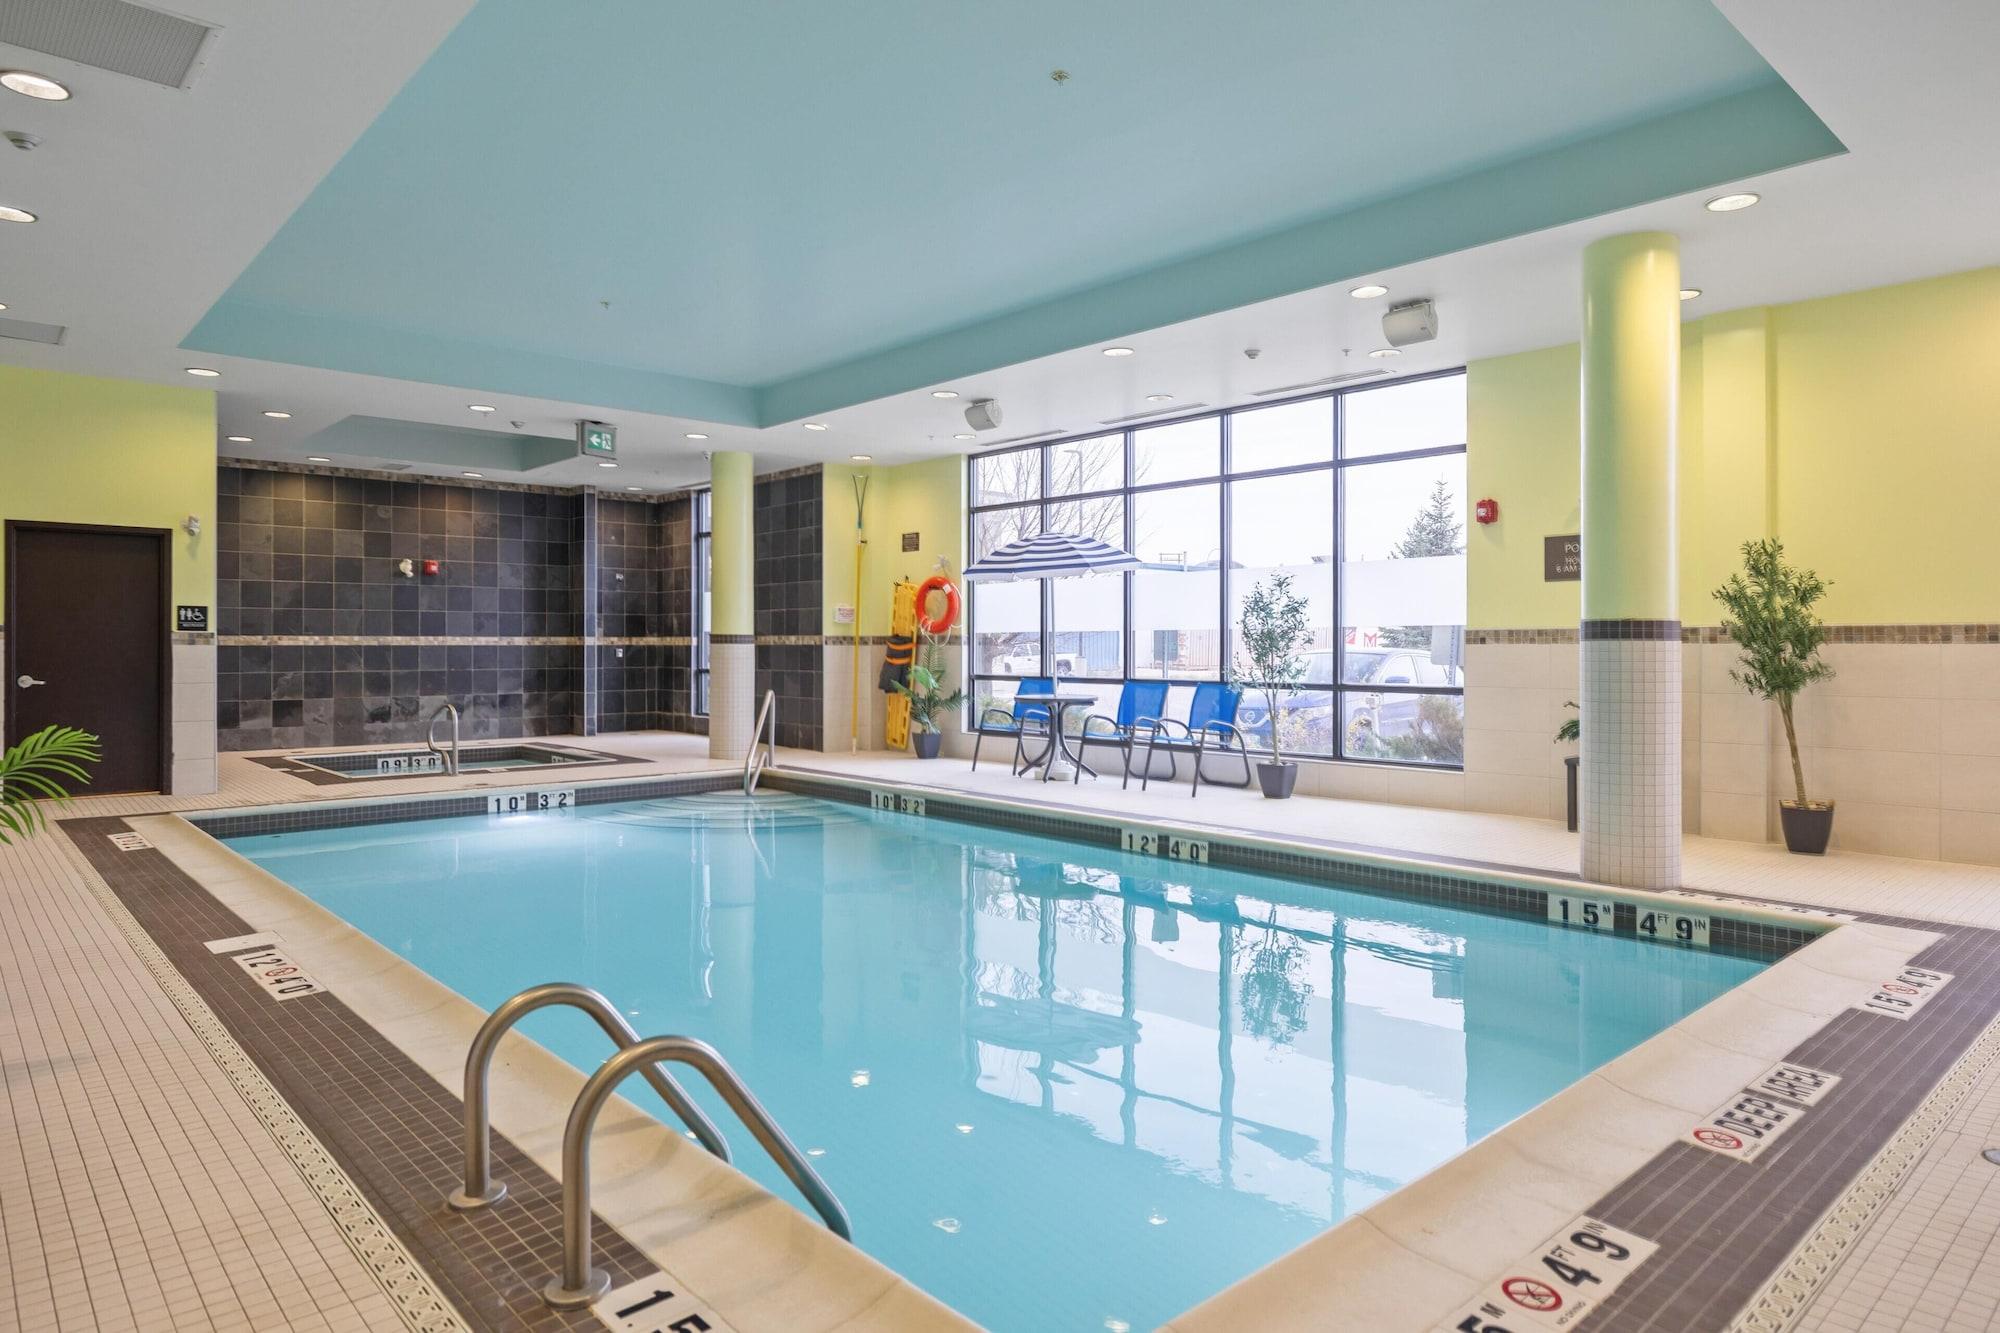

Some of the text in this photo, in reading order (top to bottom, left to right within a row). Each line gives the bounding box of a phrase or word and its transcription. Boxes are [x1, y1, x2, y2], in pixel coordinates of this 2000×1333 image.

[1565, 543, 1580, 554] PO
[1713, 1067, 1831, 1139] DEEP AREA
